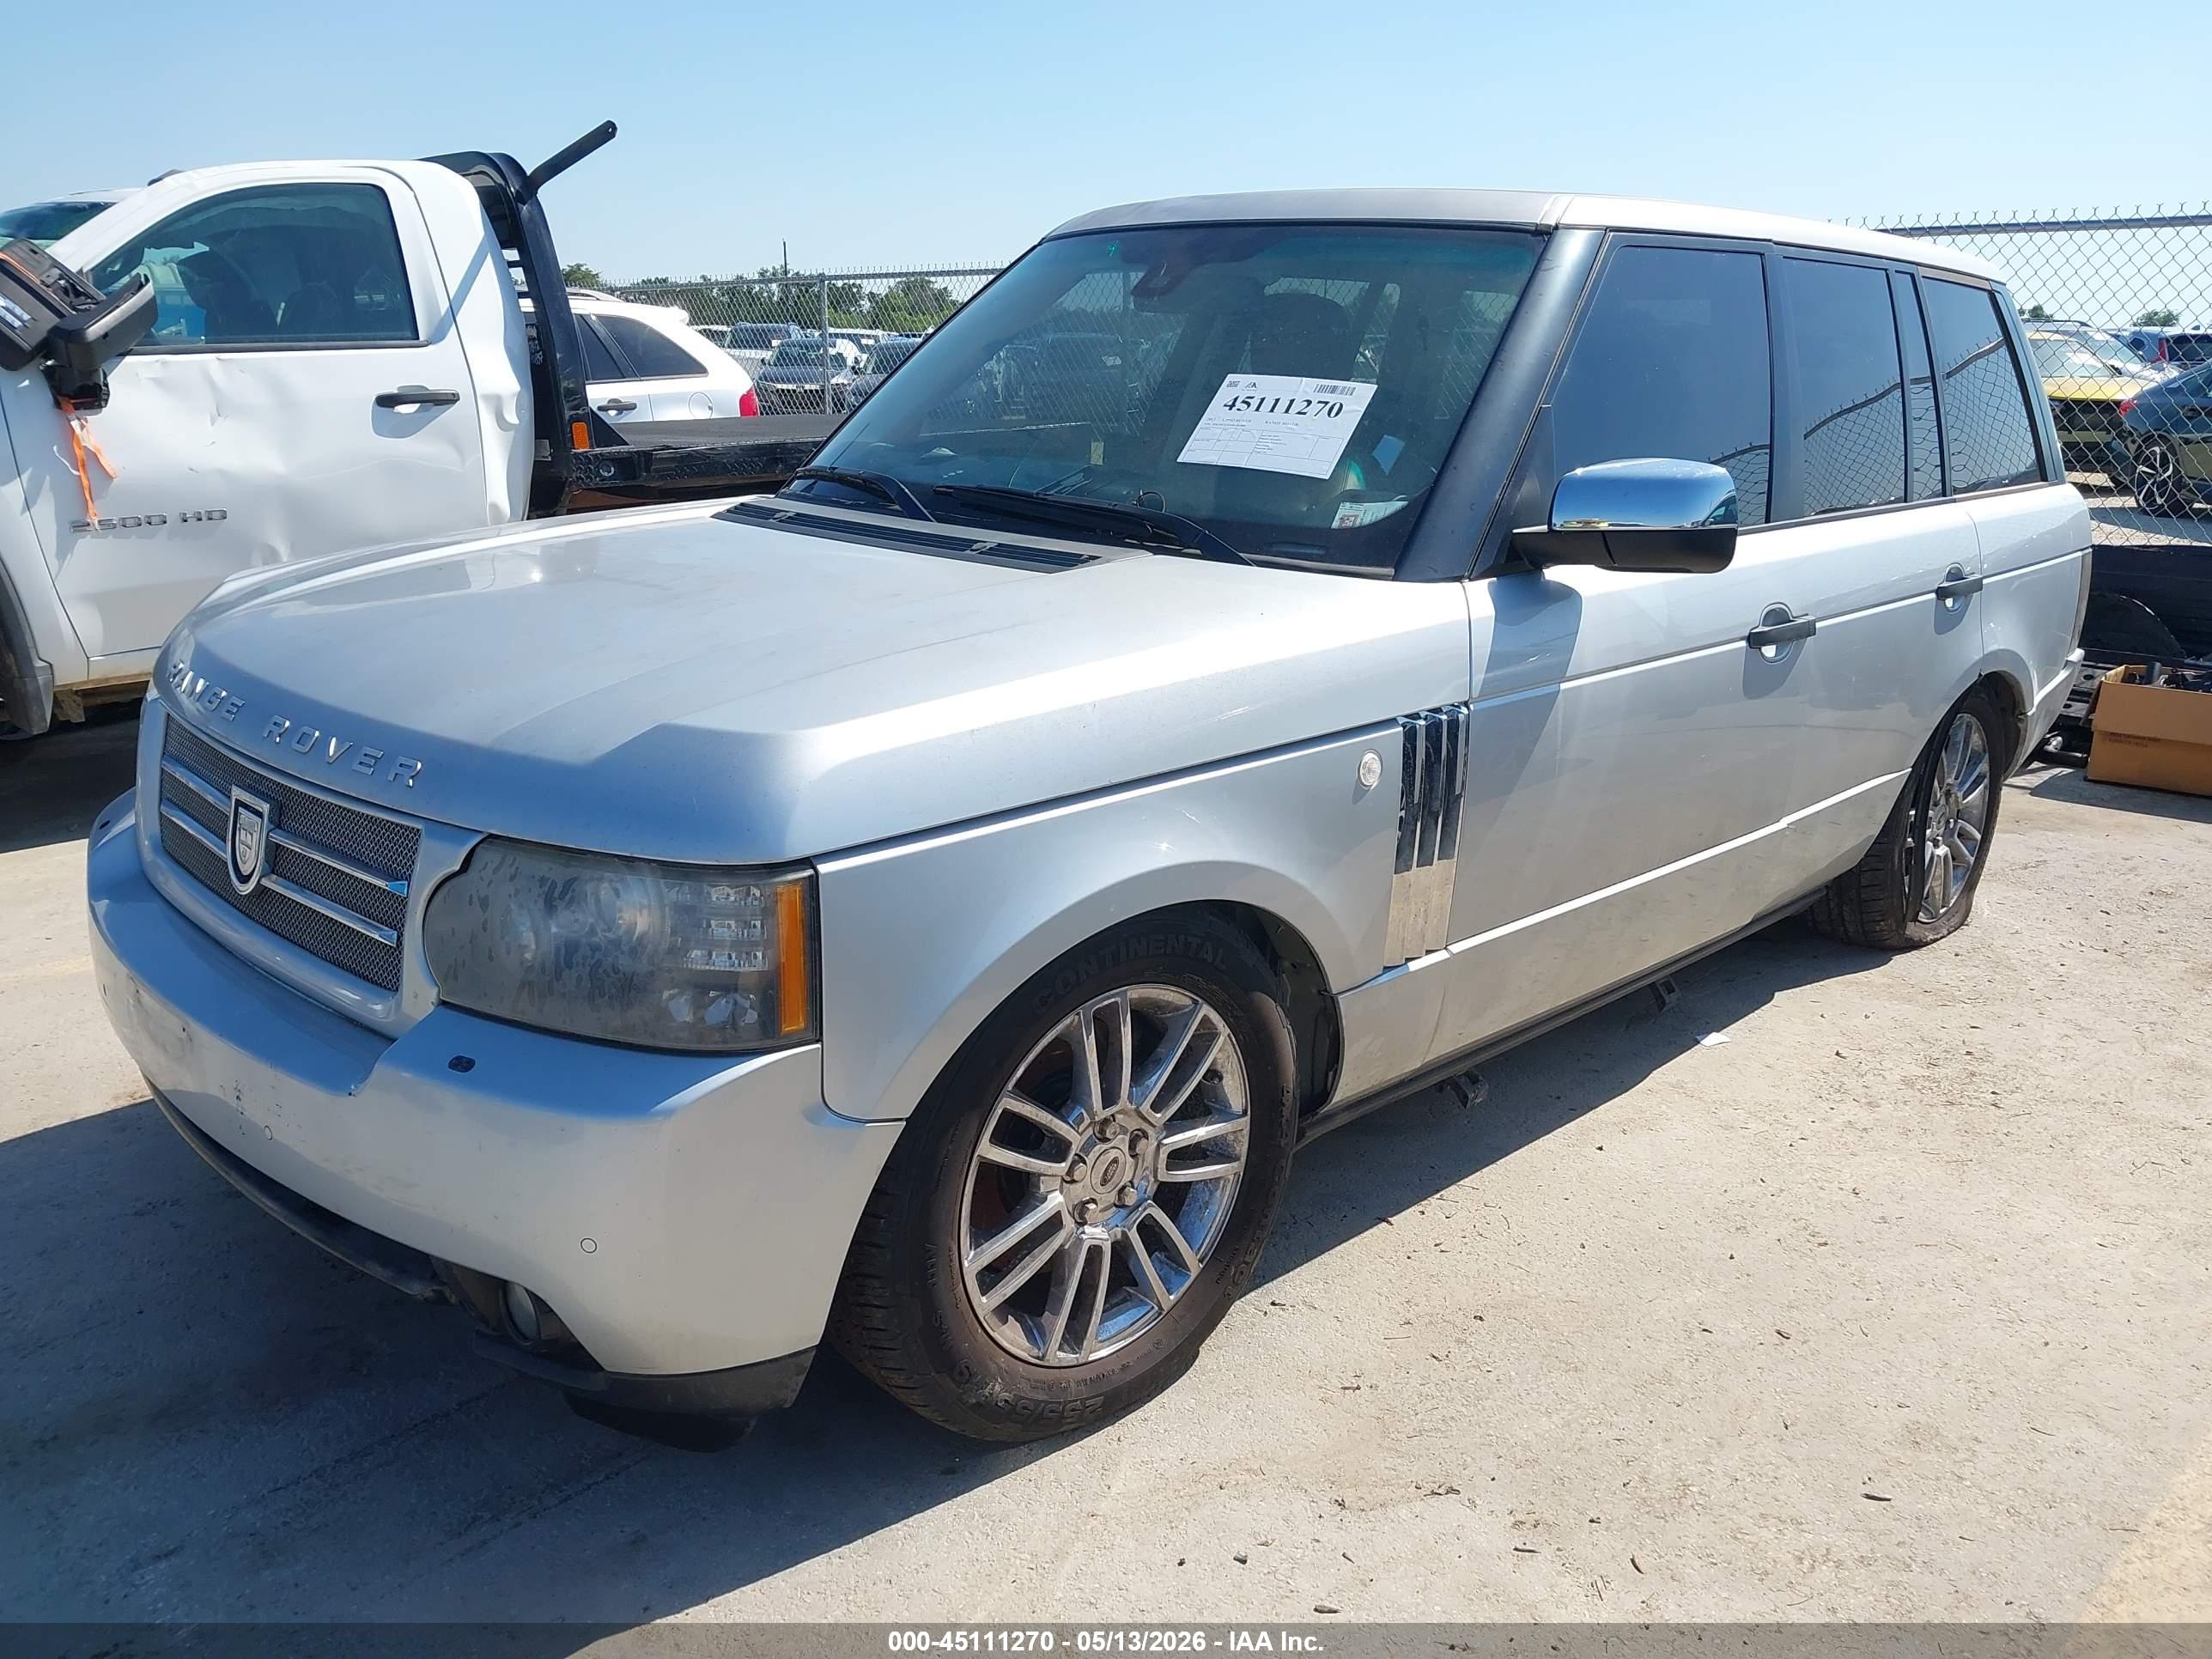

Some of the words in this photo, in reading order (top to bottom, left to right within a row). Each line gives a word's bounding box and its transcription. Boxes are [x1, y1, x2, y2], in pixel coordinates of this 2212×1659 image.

[1223, 395, 1344, 419] 45111270
[179, 507, 228, 523] HD
[167, 659, 246, 722] RANGE
[262, 714, 422, 788] ROVER
[1030, 933, 1228, 1017] CONTINENTAL
